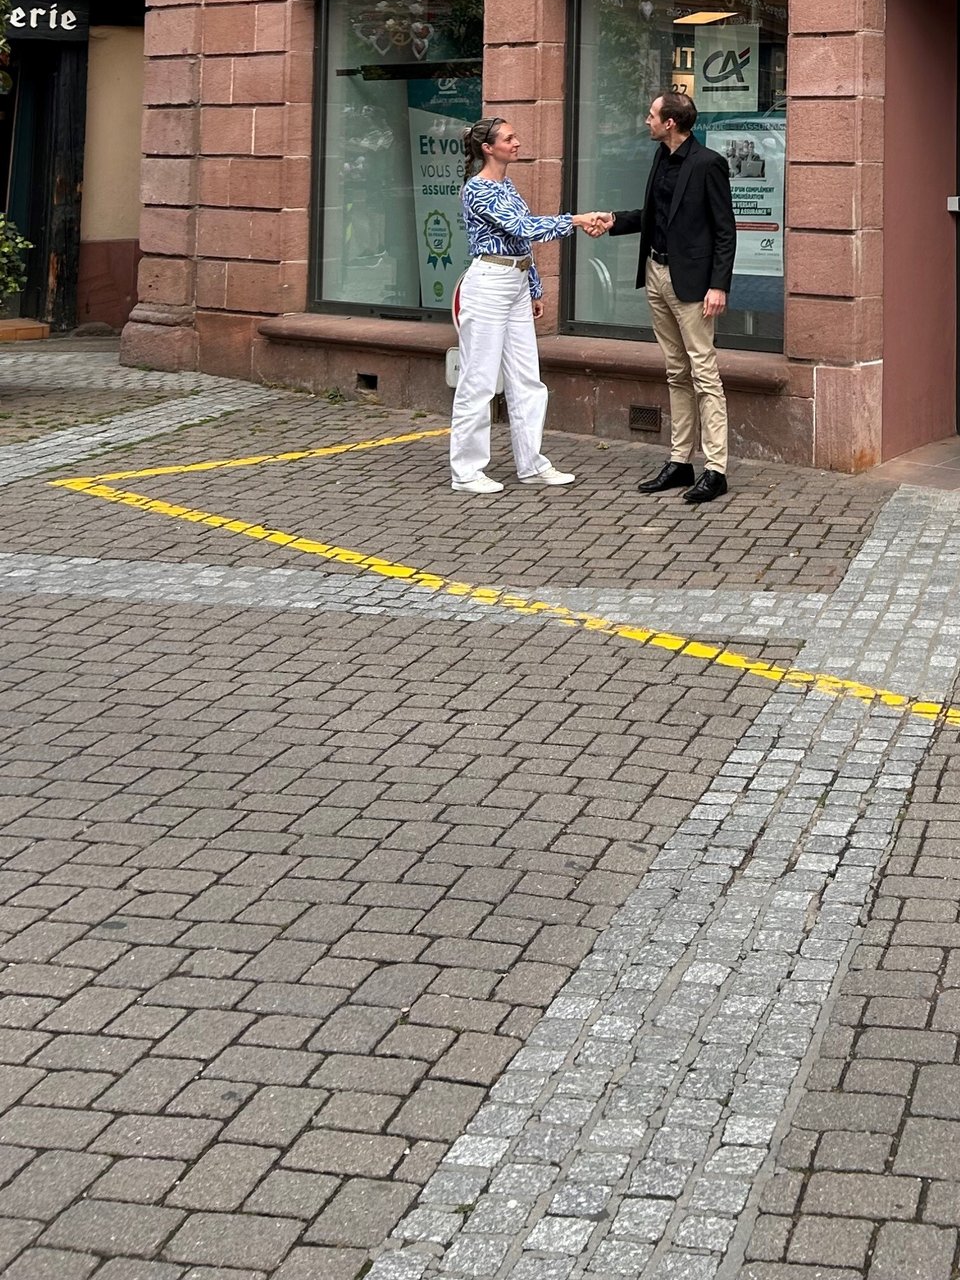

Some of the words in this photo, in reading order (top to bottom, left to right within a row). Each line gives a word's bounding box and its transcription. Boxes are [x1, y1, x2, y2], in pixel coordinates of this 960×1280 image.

[5, 3, 77, 30] erie
[420, 135, 436, 155] Et
[420, 164, 451, 178] vous
